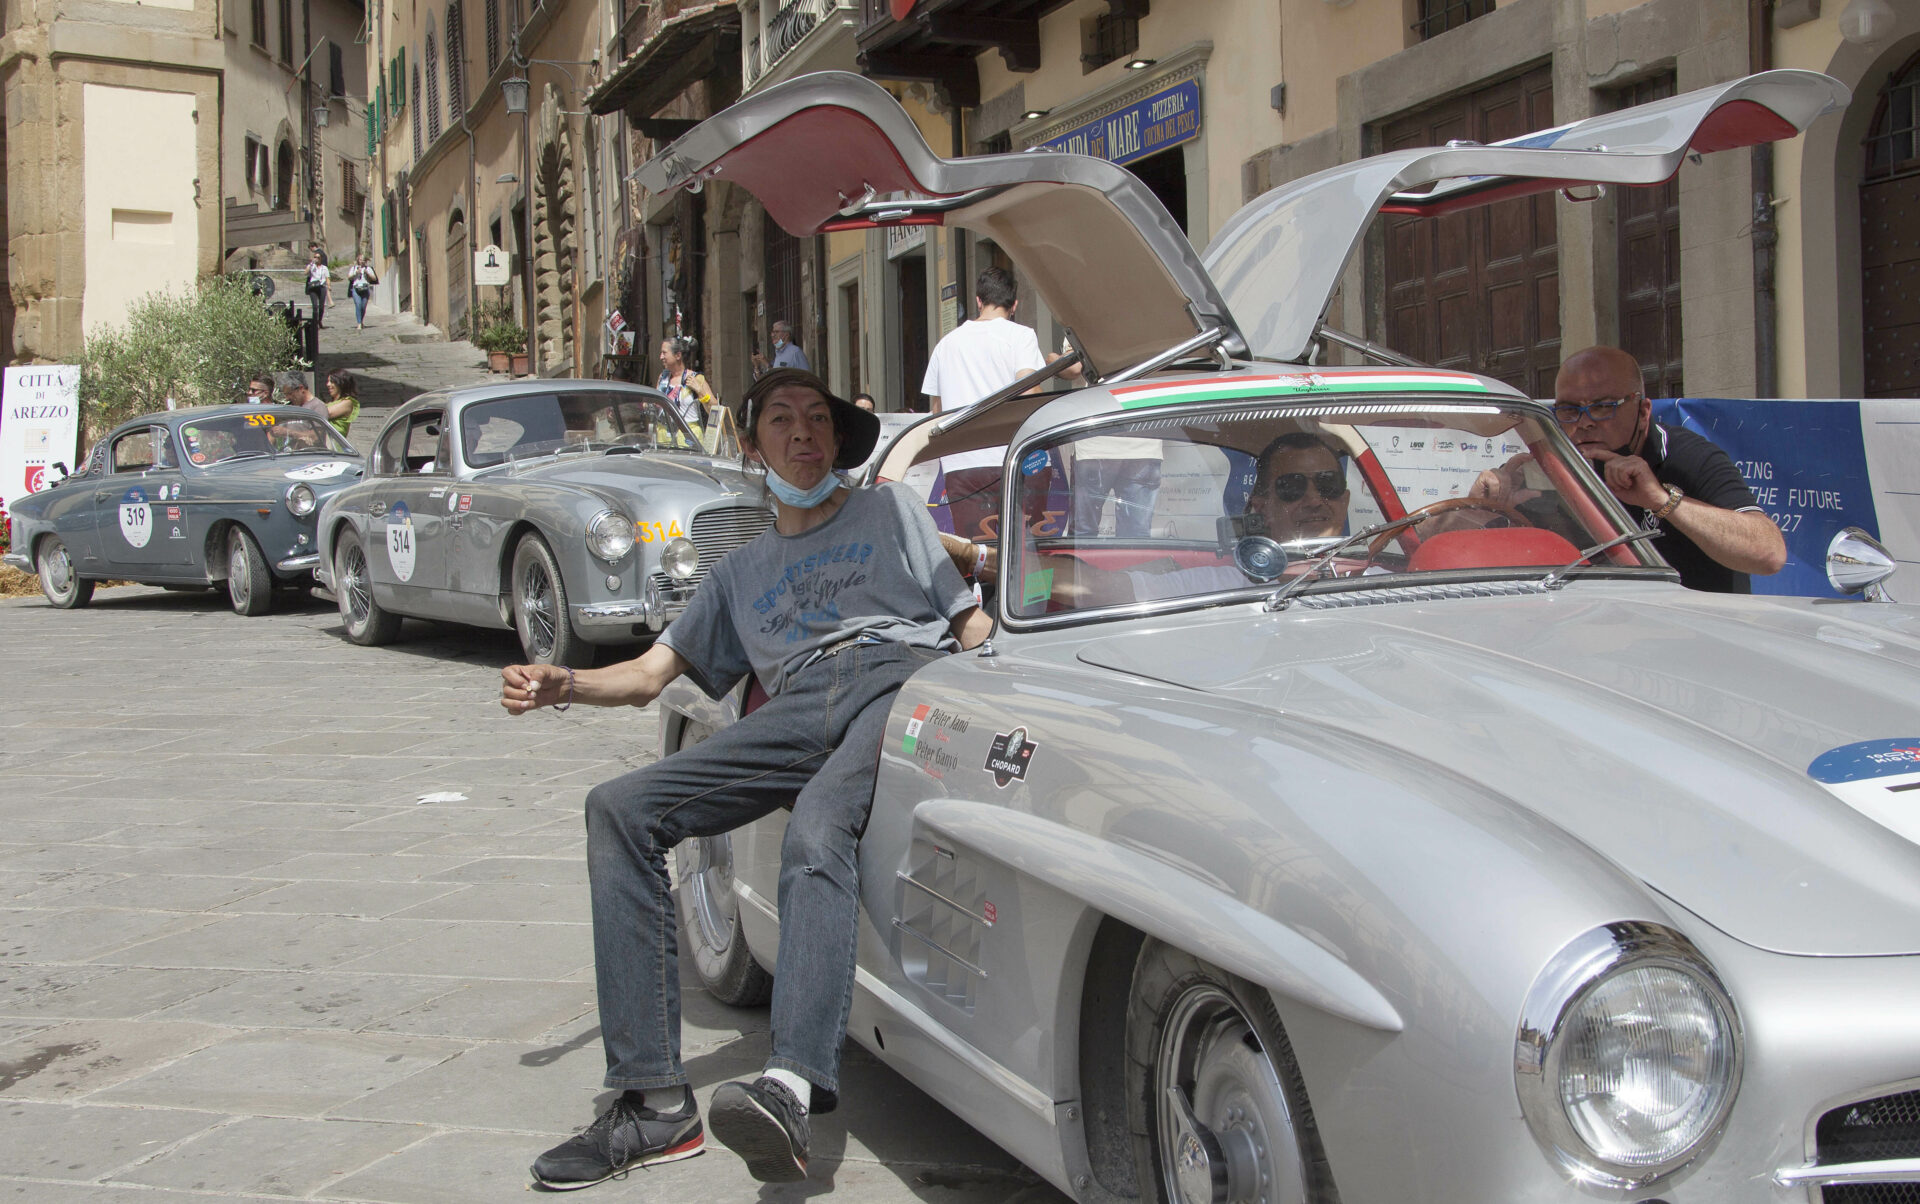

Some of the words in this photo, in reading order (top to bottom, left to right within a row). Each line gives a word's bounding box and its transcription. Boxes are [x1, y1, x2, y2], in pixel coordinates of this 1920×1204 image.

[1152, 92, 1185, 122] PIZZERIA
[1057, 131, 1089, 156] NDA
[1091, 136, 1107, 160] DEL
[1107, 110, 1141, 161] MARE
[1144, 124, 1164, 148] CUCINA
[1165, 118, 1177, 140] DEL
[1177, 109, 1195, 135] PESCE
[35, 391, 45, 400] DI
[11, 405, 69, 419] AREZZO
[244, 414, 276, 426] 319
[1749, 486, 1778, 505] THE
[1788, 488, 1843, 511] FUTURE
[126, 507, 146, 526] 319
[1770, 513, 1803, 532] 27
[392, 529, 410, 553] 314
[637, 519, 684, 543] 314
[928, 708, 952, 730] Péter
[915, 740, 939, 762] Péter
[991, 758, 1021, 775] CHOPARD
